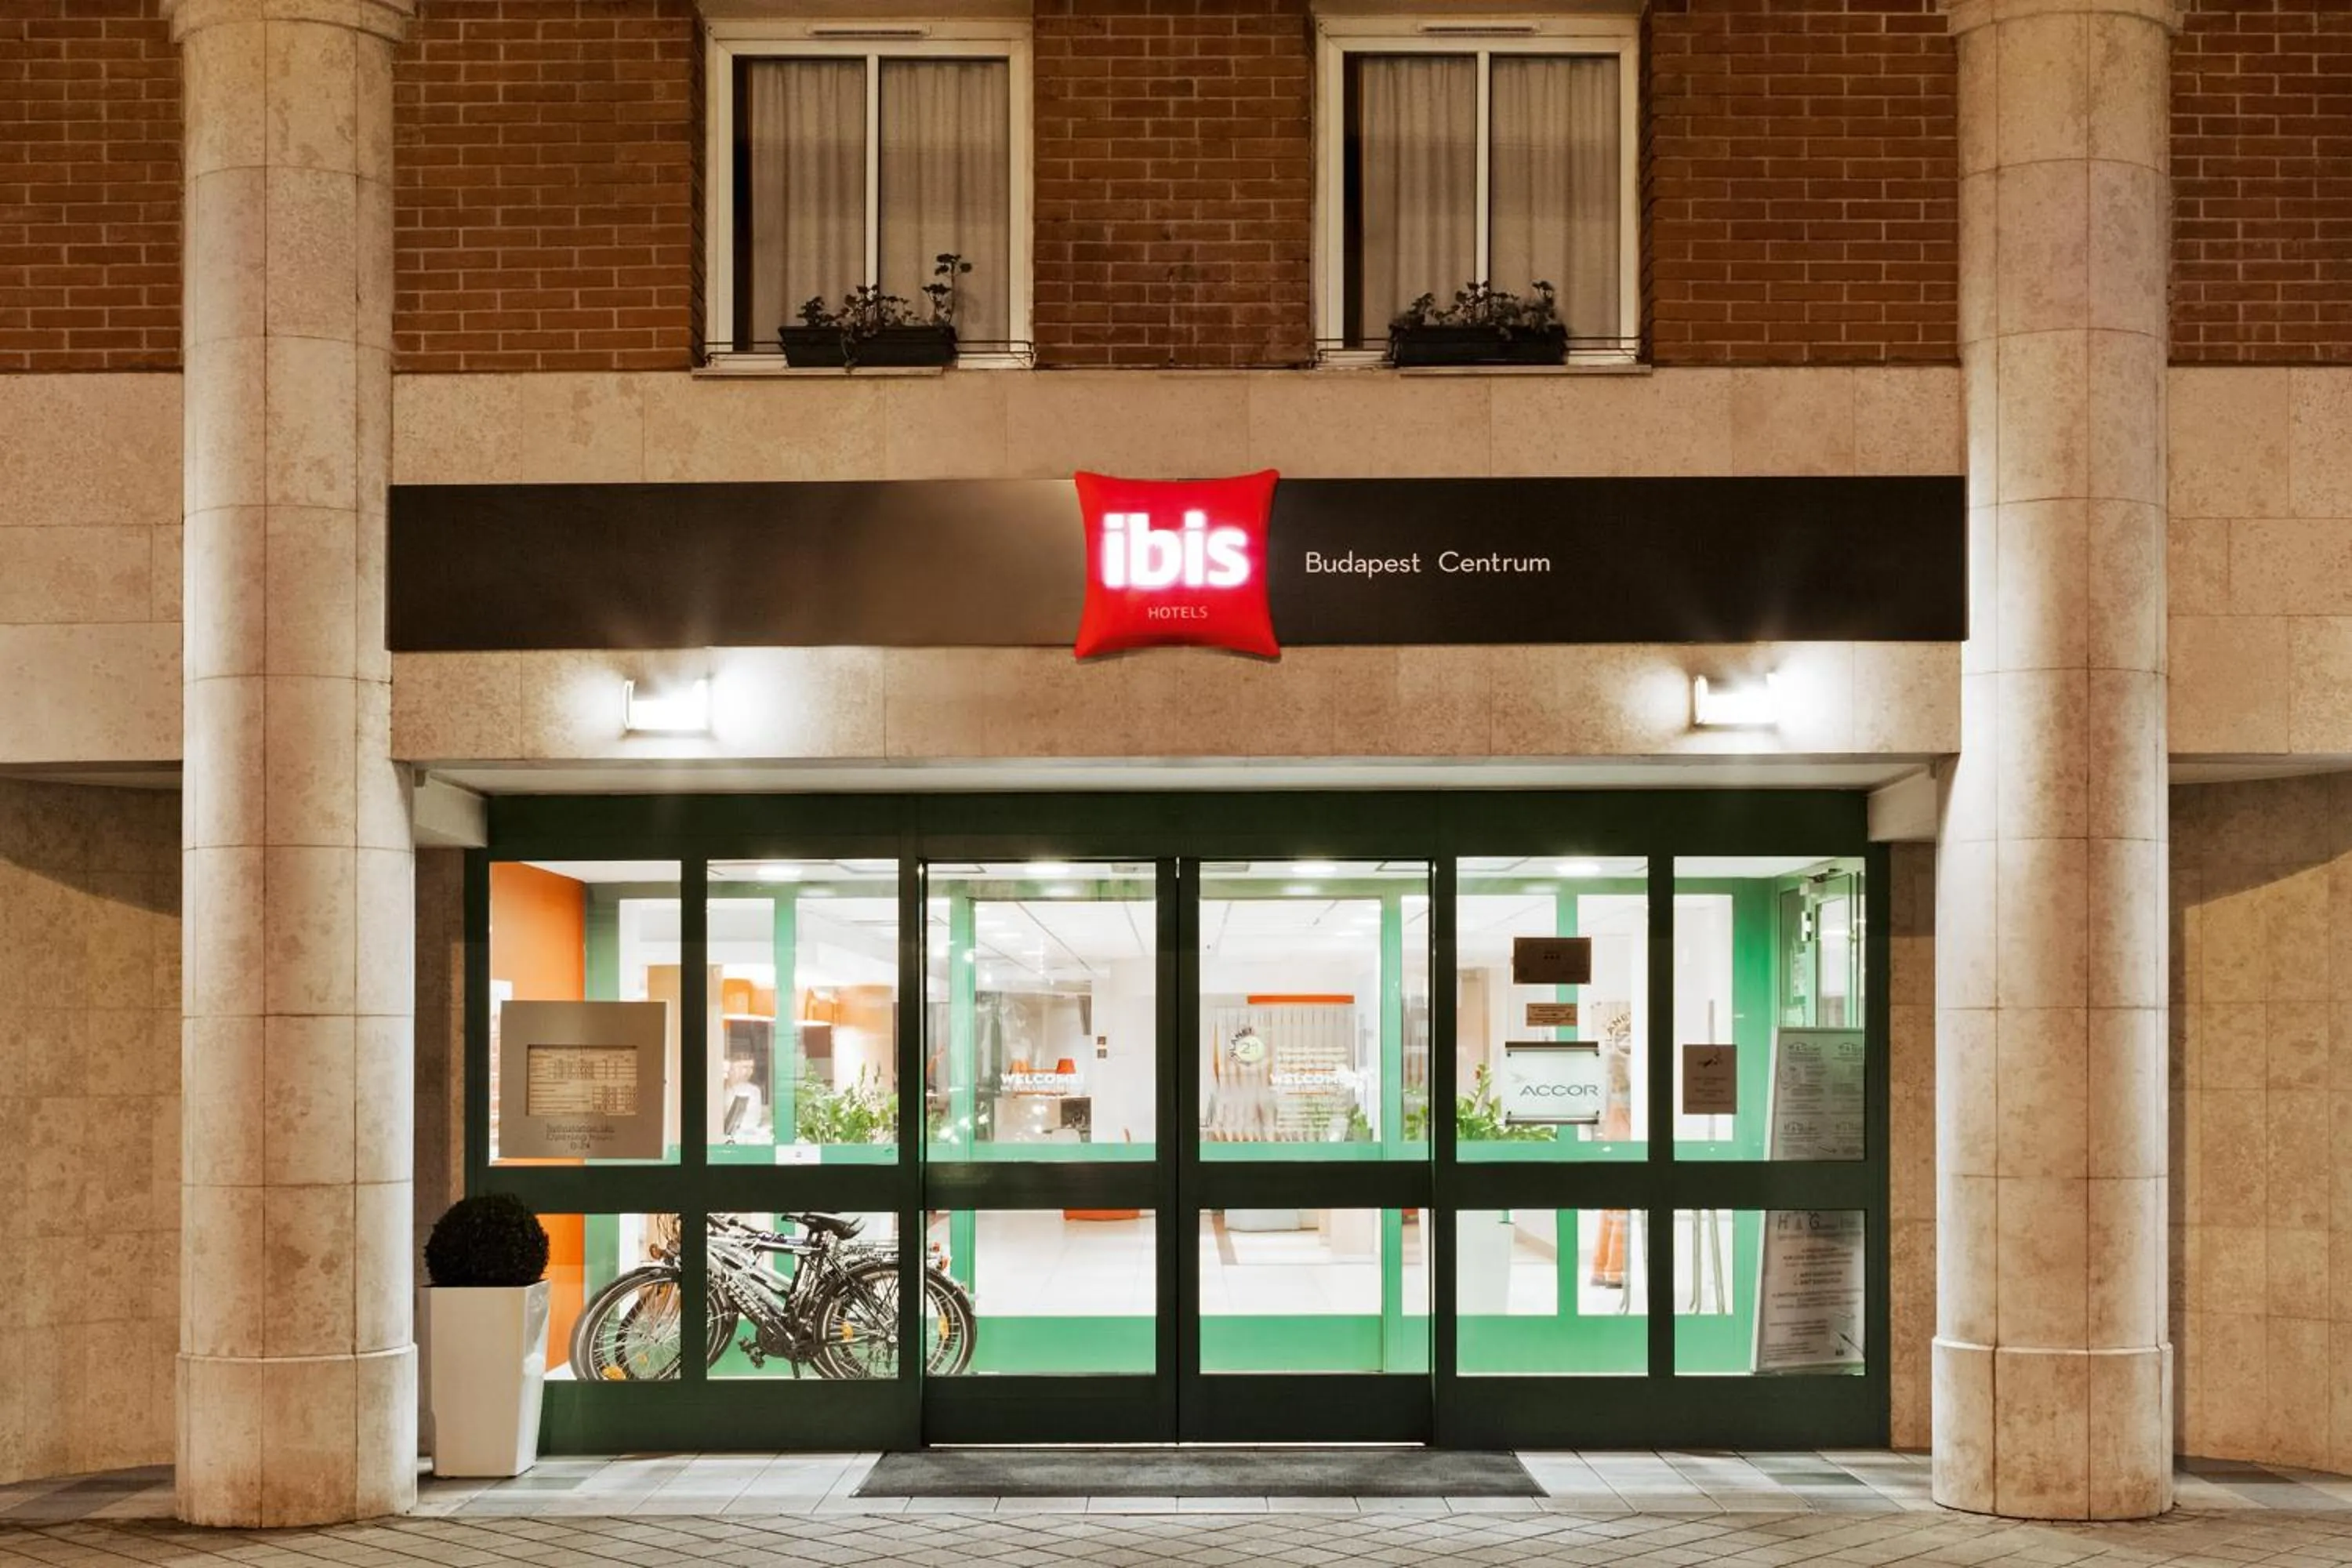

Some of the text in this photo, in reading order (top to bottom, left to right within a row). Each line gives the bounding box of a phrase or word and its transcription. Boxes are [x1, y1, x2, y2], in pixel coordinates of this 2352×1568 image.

[1102, 510, 1252, 590] ibis
[1305, 550, 1550, 579] Budapest Centrum
[1147, 605, 1208, 619] HOTELS
[1519, 1083, 1599, 1097] ACCOR
